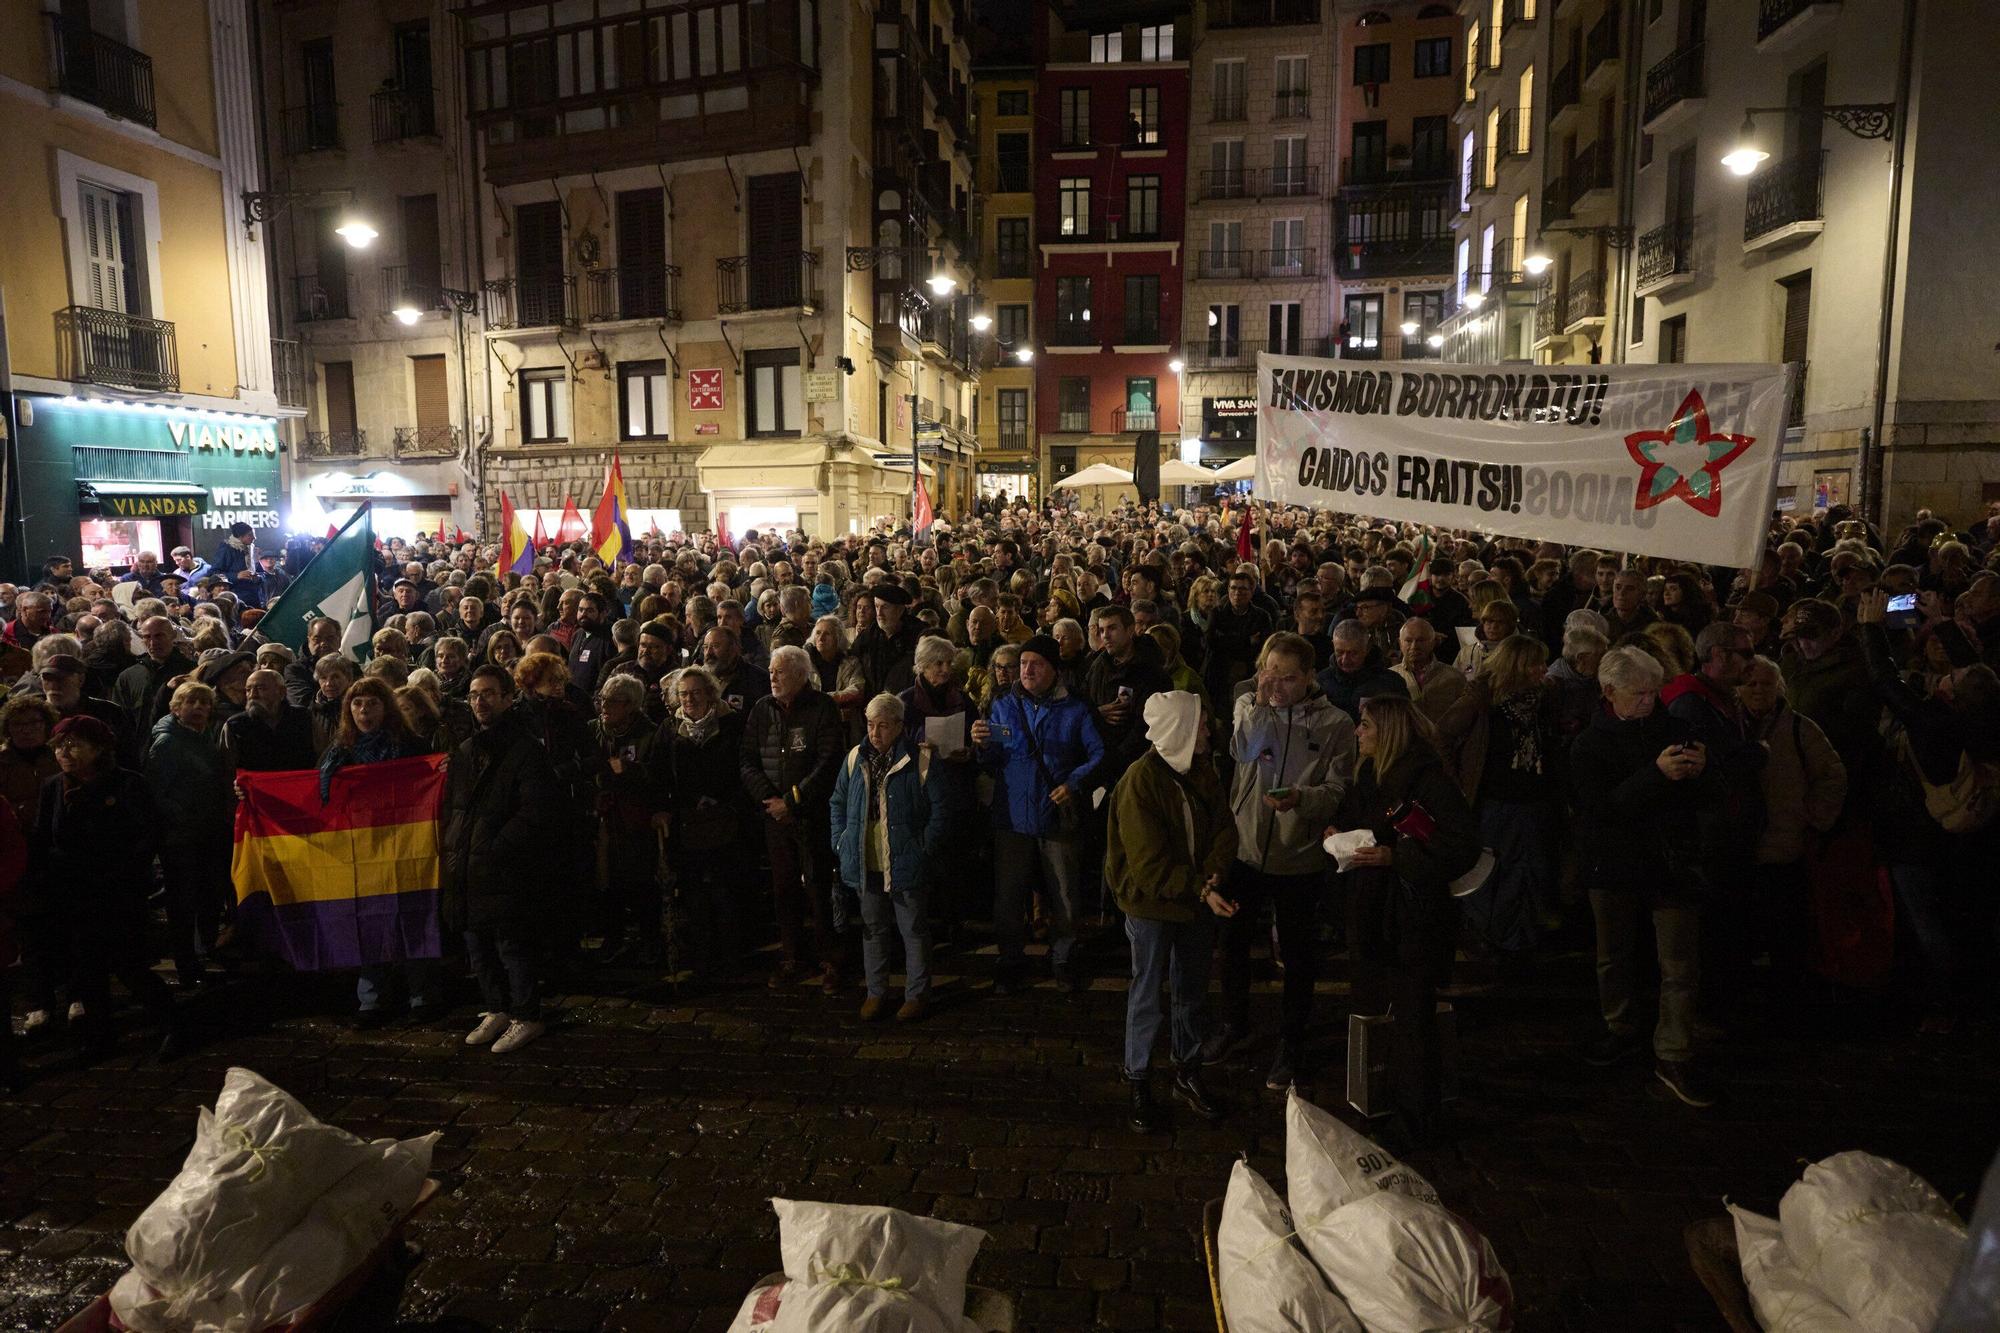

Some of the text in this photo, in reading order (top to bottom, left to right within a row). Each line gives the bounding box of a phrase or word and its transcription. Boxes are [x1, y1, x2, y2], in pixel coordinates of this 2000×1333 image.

[1237, 399, 1257, 409] SAN
[1270, 368, 1609, 425] FAXISMOA BORROKATU!
[167, 420, 276, 457] VIANDAS
[1298, 446, 1523, 514] CAIDOS ERAITSI!
[113, 497, 198, 515] VIANDAS
[211, 487, 268, 506] WE'RE
[202, 510, 280, 530] FARMERS
